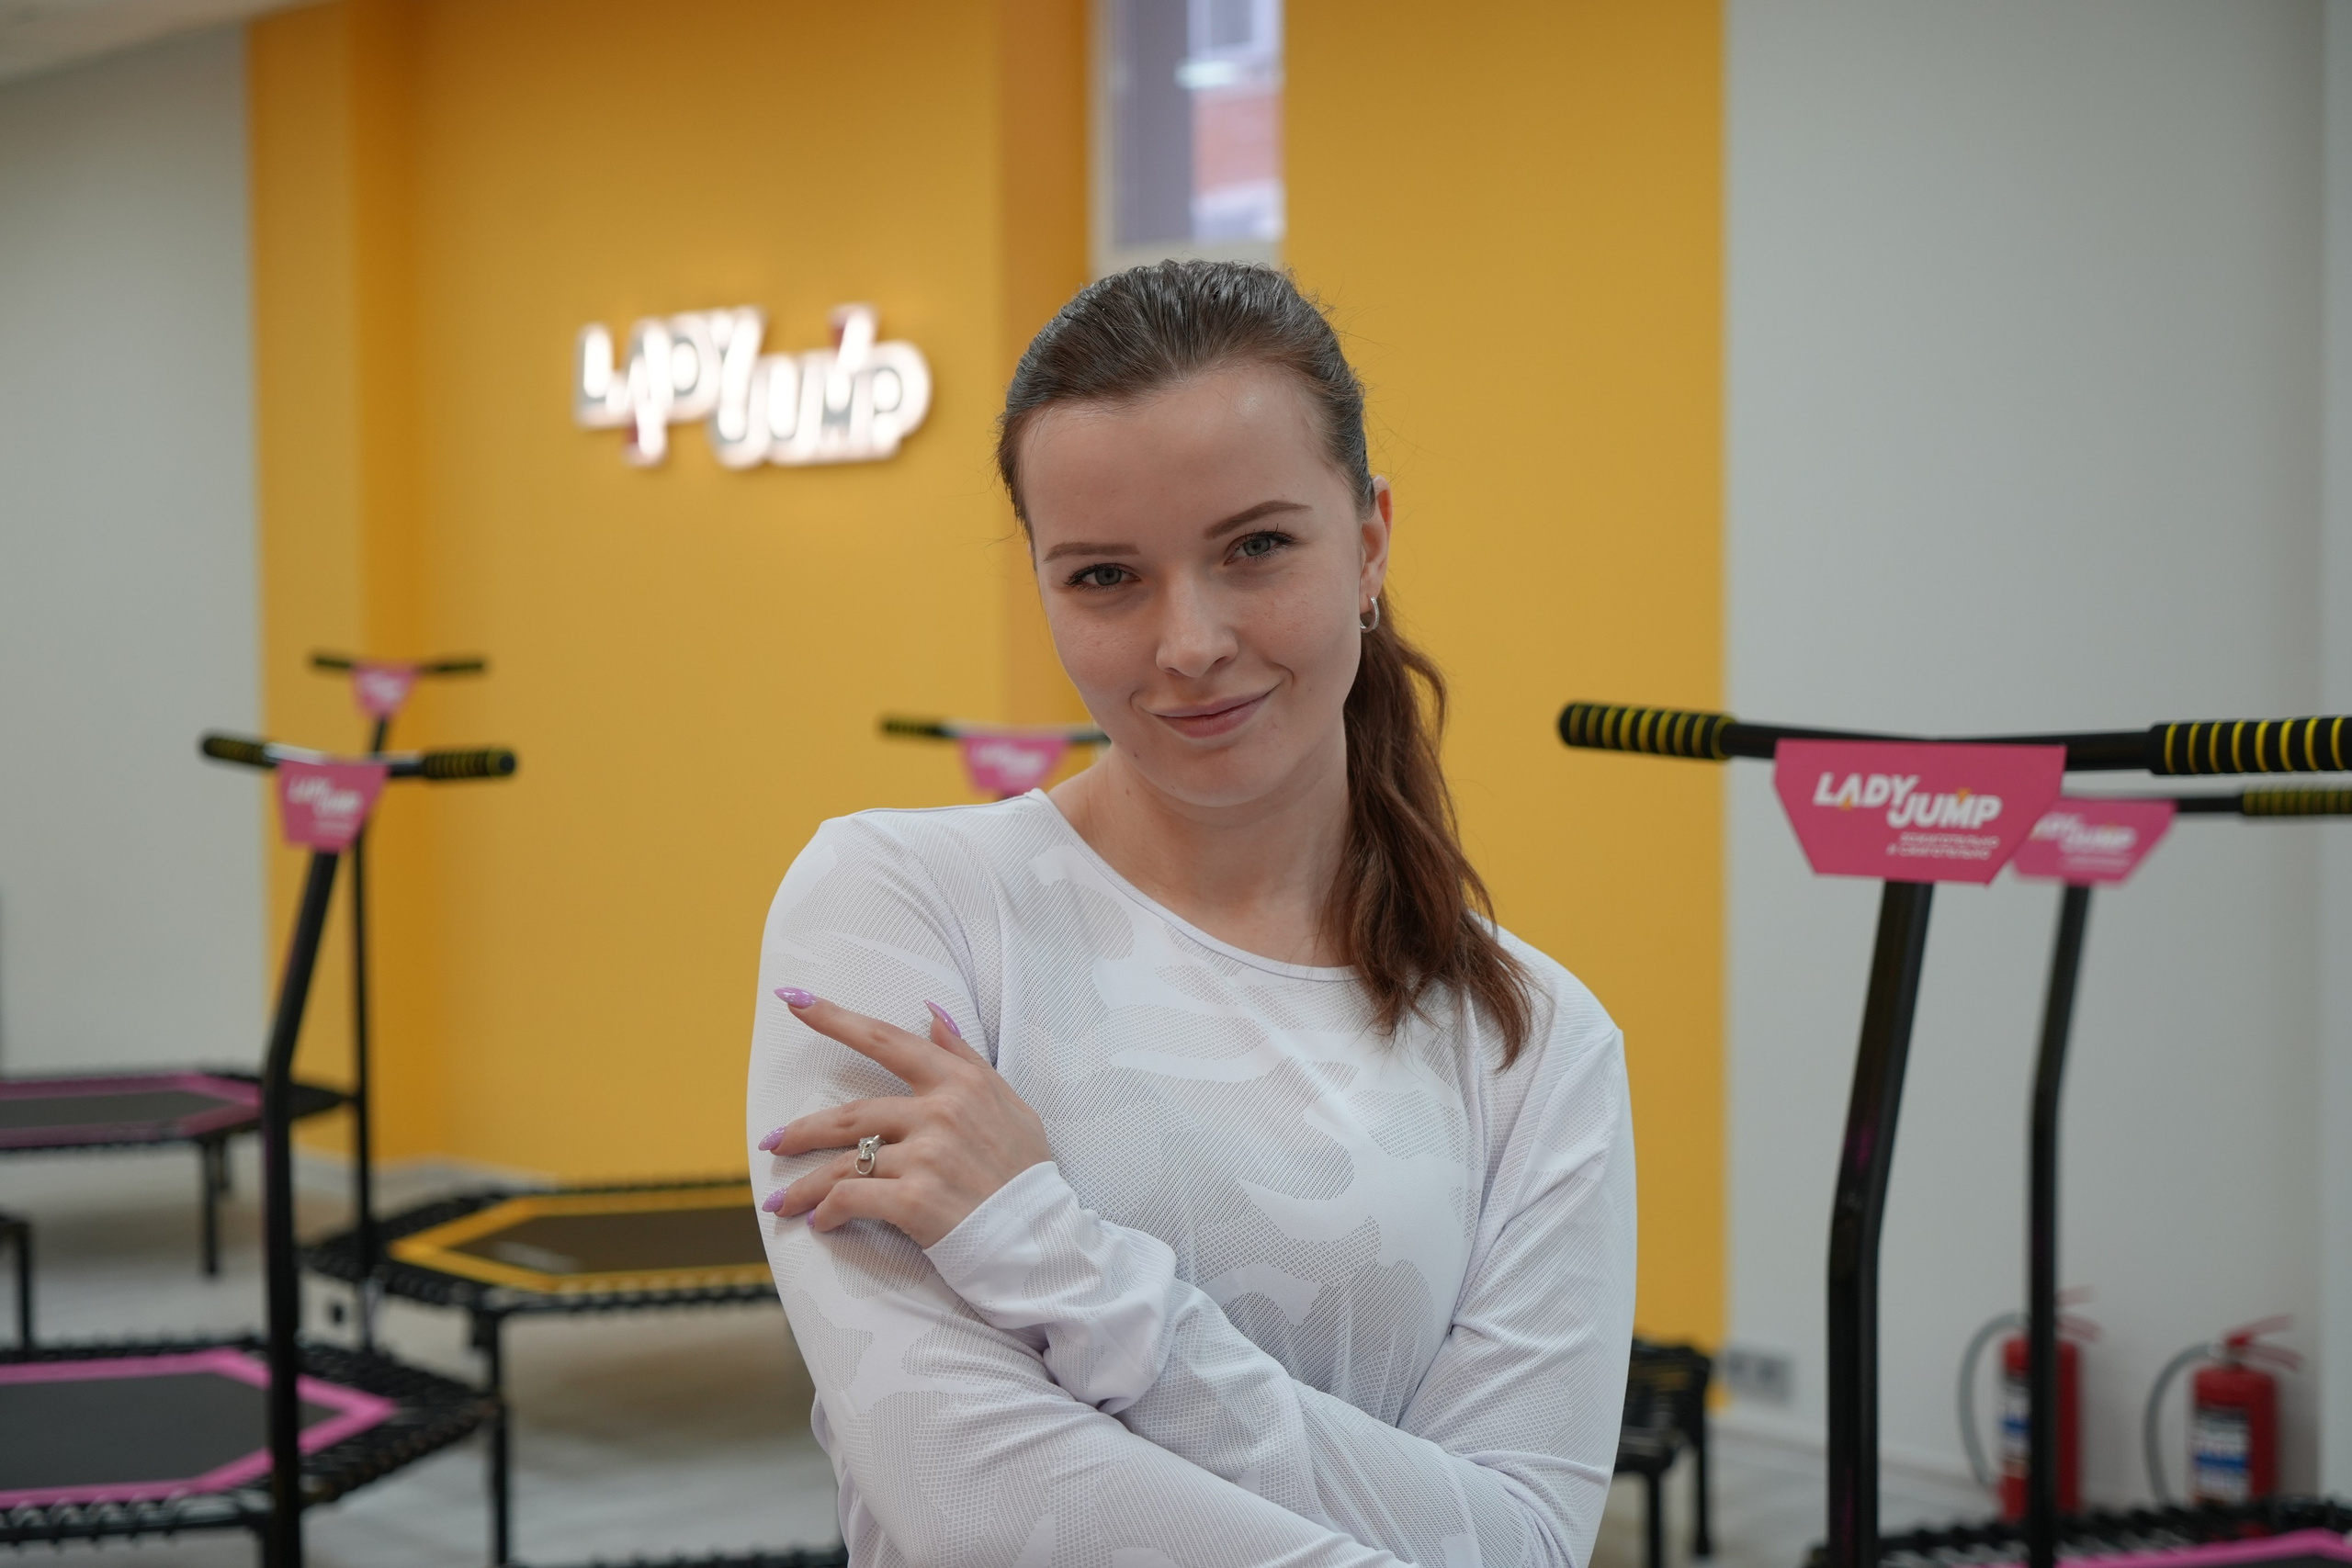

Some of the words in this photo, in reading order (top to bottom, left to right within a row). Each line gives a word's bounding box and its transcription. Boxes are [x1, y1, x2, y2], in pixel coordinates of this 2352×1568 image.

[575, 306, 764, 465] LADY
[1812, 770, 1920, 810] LADY
[1886, 787, 2003, 829] JUMP
